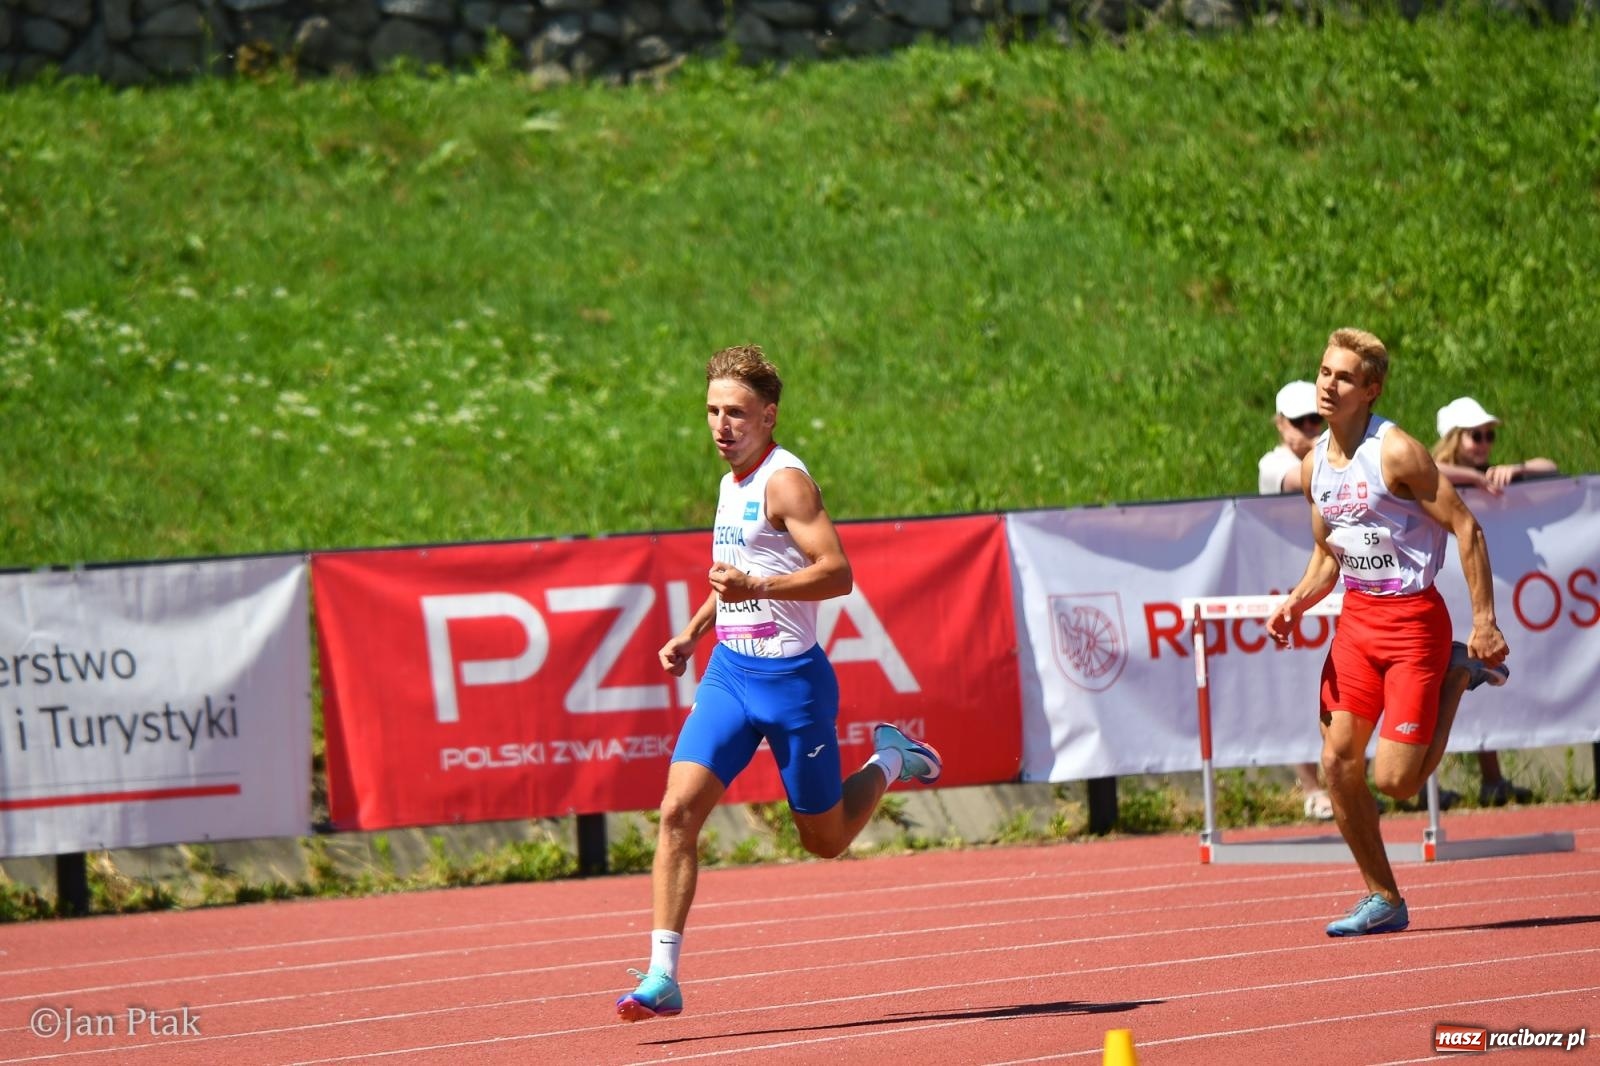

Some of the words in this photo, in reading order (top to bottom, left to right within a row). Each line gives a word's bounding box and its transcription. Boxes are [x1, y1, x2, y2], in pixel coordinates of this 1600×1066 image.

[1322, 502, 1369, 516] POLSKA
[1363, 532, 1380, 546] 55
[1512, 566, 1600, 632] OS
[15, 708, 27, 751] i
[39, 694, 238, 754] Turystyki
[440, 743, 545, 771] POLSKI
[551, 734, 675, 763] ZWIĄZEK
